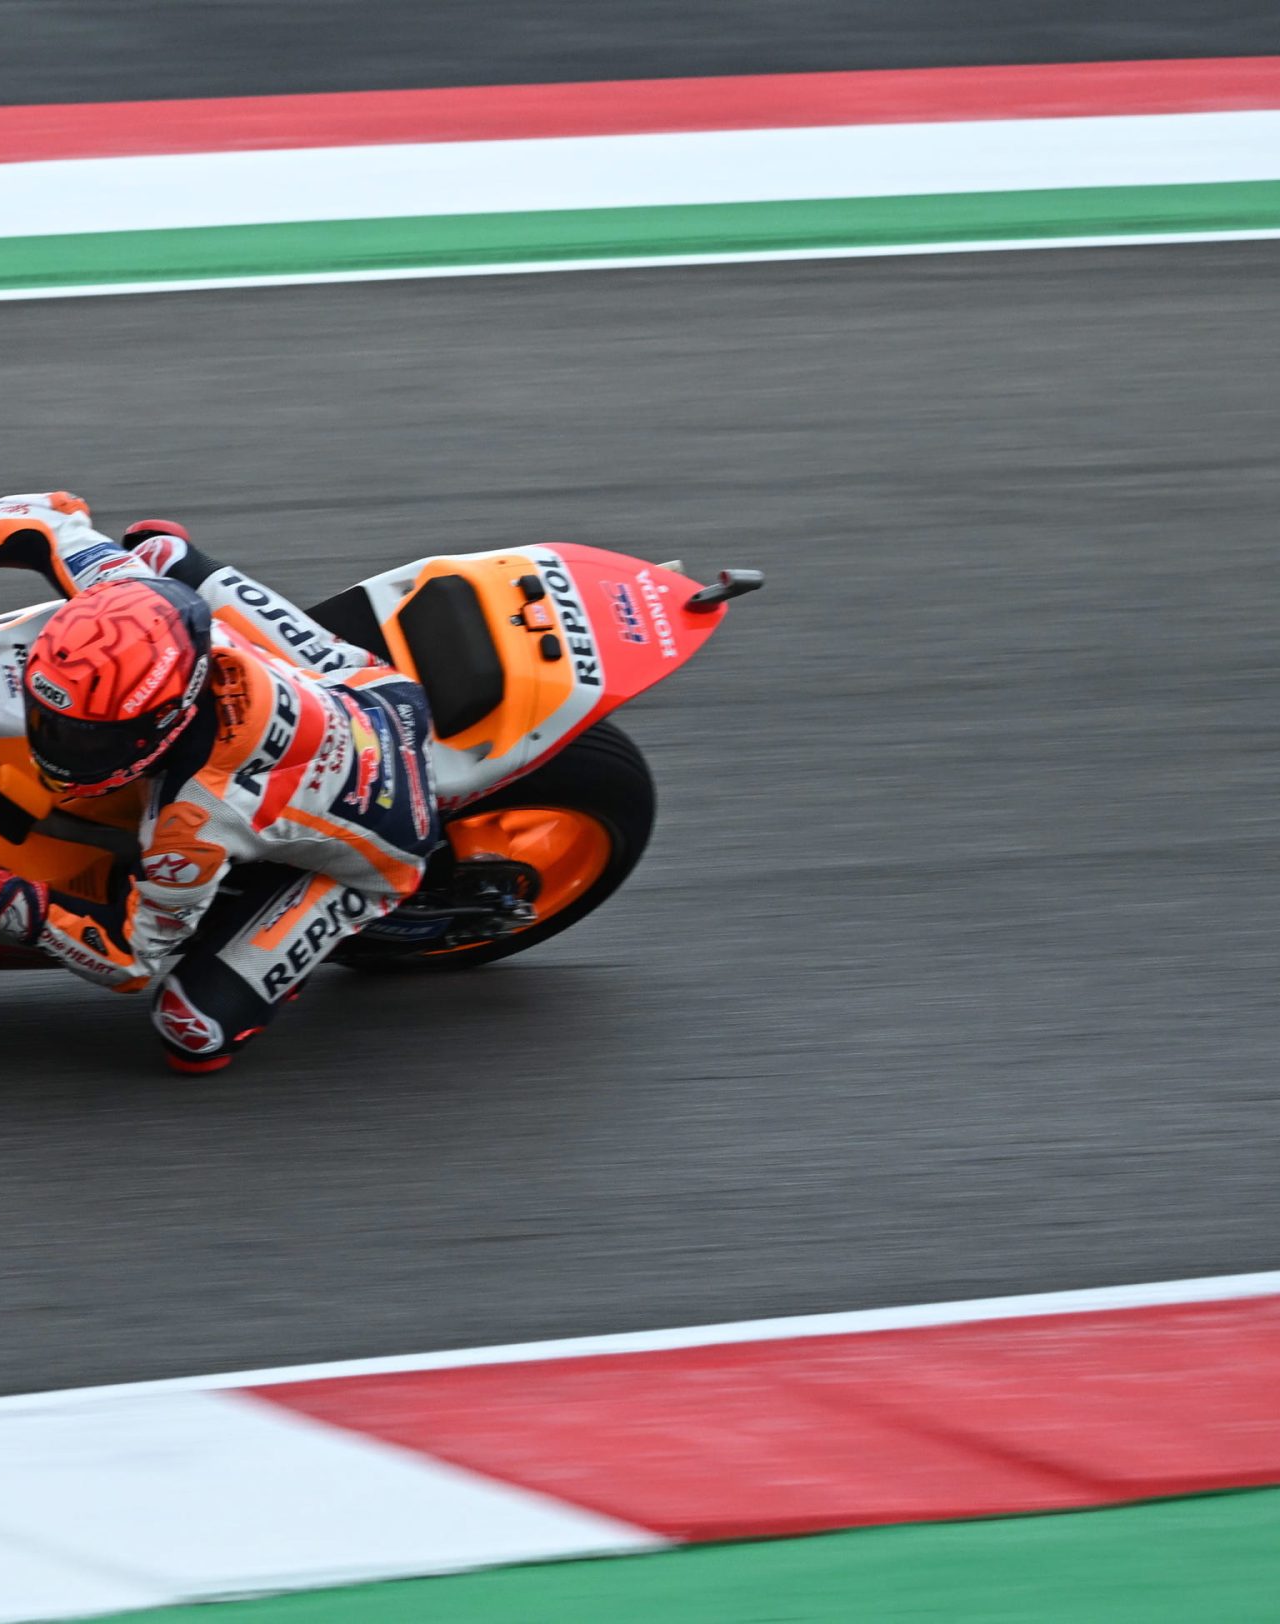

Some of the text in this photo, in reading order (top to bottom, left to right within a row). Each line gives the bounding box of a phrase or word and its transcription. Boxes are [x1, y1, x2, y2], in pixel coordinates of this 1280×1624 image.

[538, 556, 601, 686] REPSOL
[635, 569, 677, 657] HONDA
[33, 675, 66, 706] SHOEI
[122, 647, 179, 713] PULL&BEAR
[234, 683, 296, 796] REP
[65, 946, 116, 975] HEART
[262, 887, 366, 999] REPSO
